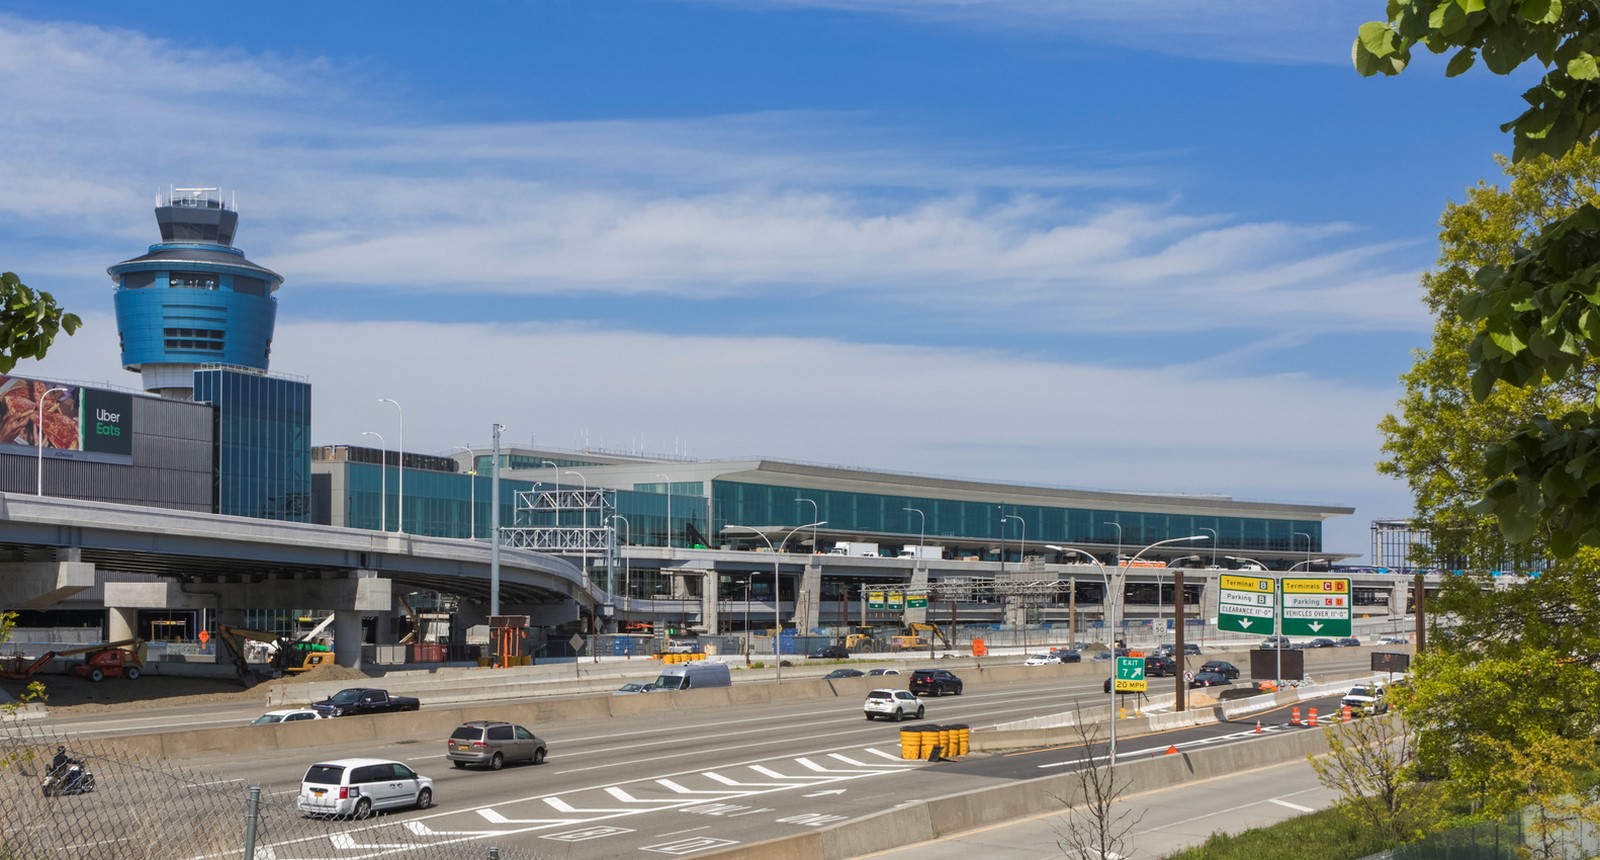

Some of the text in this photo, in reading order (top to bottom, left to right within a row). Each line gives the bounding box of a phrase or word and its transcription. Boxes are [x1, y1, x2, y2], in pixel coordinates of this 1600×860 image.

[96, 408, 121, 423] Uber
[96, 422, 121, 437] Eats
[1226, 579, 1254, 588] Terminal
[1324, 582, 1331, 590] C
[1336, 582, 1344, 590] D
[1226, 593, 1252, 602] Parking
[1293, 598, 1320, 607] Parking
[1222, 606, 1254, 614] CLEARANCE
[1122, 668, 1129, 677] 7
